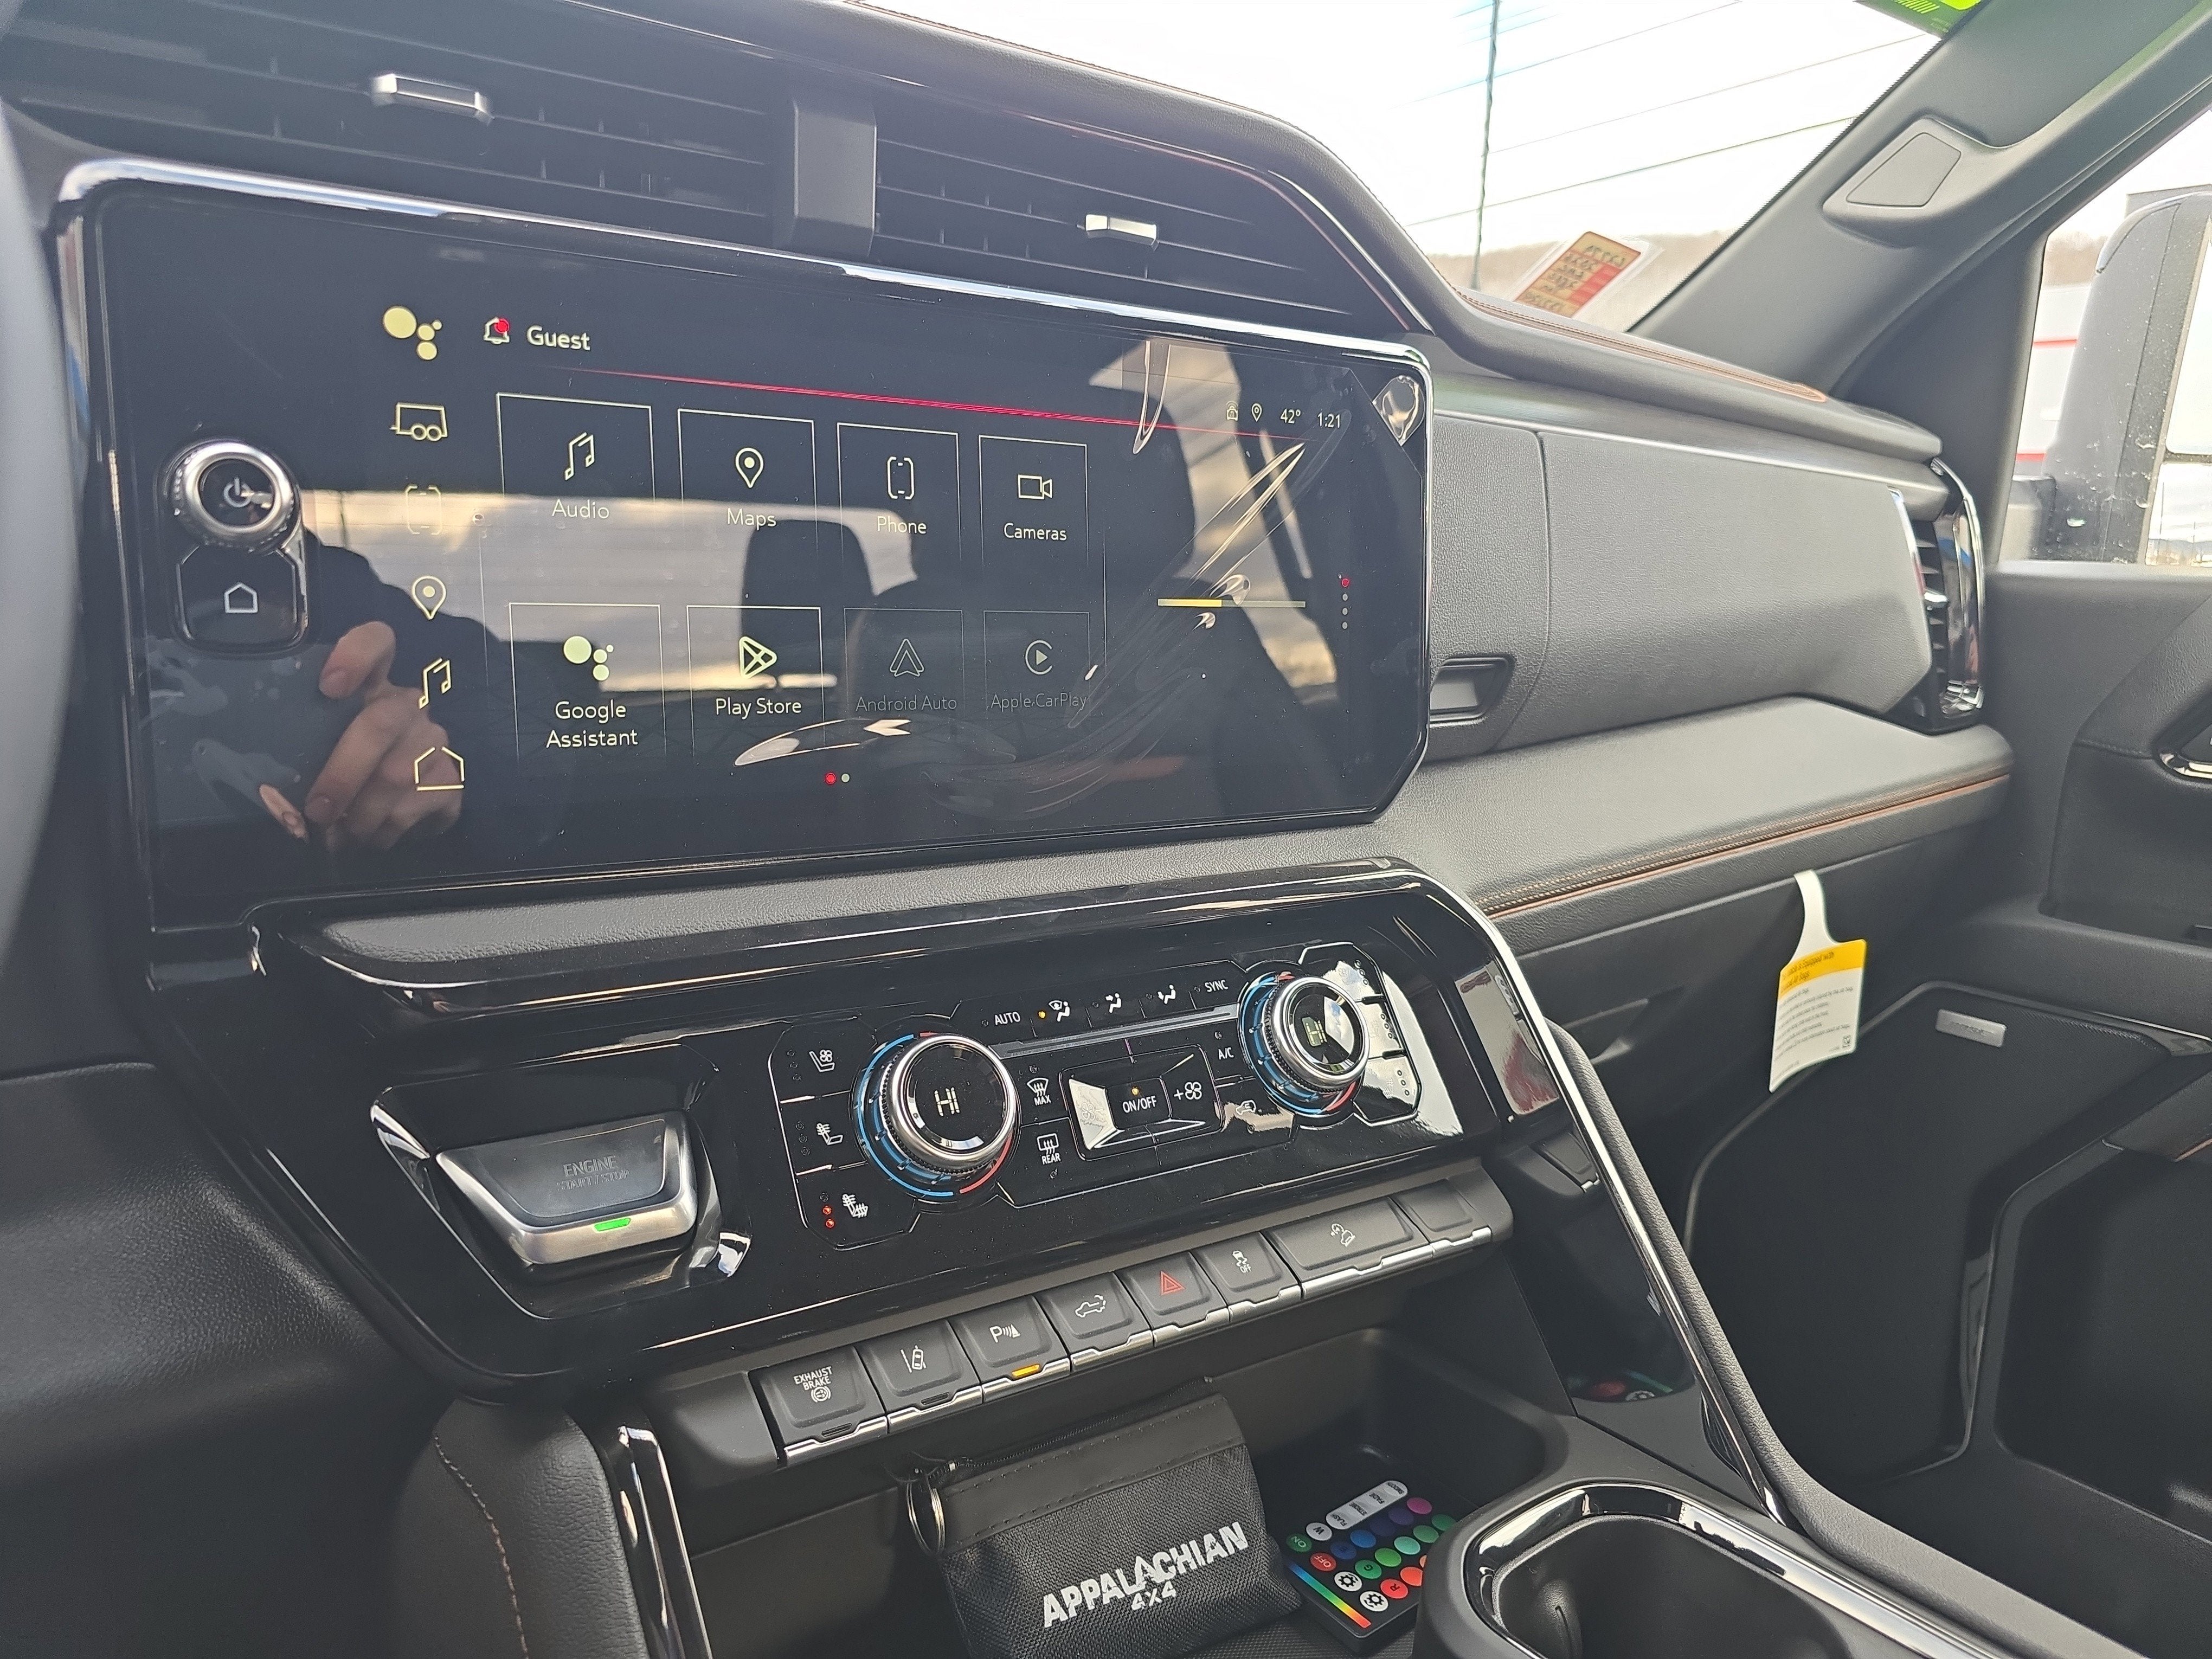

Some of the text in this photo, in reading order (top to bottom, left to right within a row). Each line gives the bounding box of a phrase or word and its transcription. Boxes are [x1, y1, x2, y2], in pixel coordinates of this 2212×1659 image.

[527, 325, 591, 351] Guest
[1317, 412, 1341, 429] 1:21
[551, 499, 610, 520] Audio
[726, 508, 777, 530] Maps
[876, 516, 927, 535] Phone
[1003, 522, 1068, 542] Cameras
[555, 699, 627, 723] Google
[716, 697, 802, 720] Play Store
[856, 695, 957, 712] Android Auto
[991, 692, 1087, 713] Apple CarPlay
[545, 729, 639, 748] Assistant
[1204, 979, 1229, 993] SYNC
[994, 1011, 1021, 1026] AUTO
[1218, 1047, 1235, 1060] A/C
[1034, 1095, 1052, 1106] MAX
[1122, 1095, 1157, 1114] ON/OFF
[563, 1155, 619, 1177] ENGINE
[1041, 1152, 1061, 1165] REAR
[793, 1366, 832, 1385] EXHAUST
[802, 1375, 831, 1391] BRAKE
[1369, 1492, 1385, 1504] FADE
[1290, 1536, 1307, 1548] ON
[1313, 1555, 1332, 1568] OFF
[1044, 1521, 1248, 1628] APPALACHIAN
[1390, 1583, 1400, 1592] R
